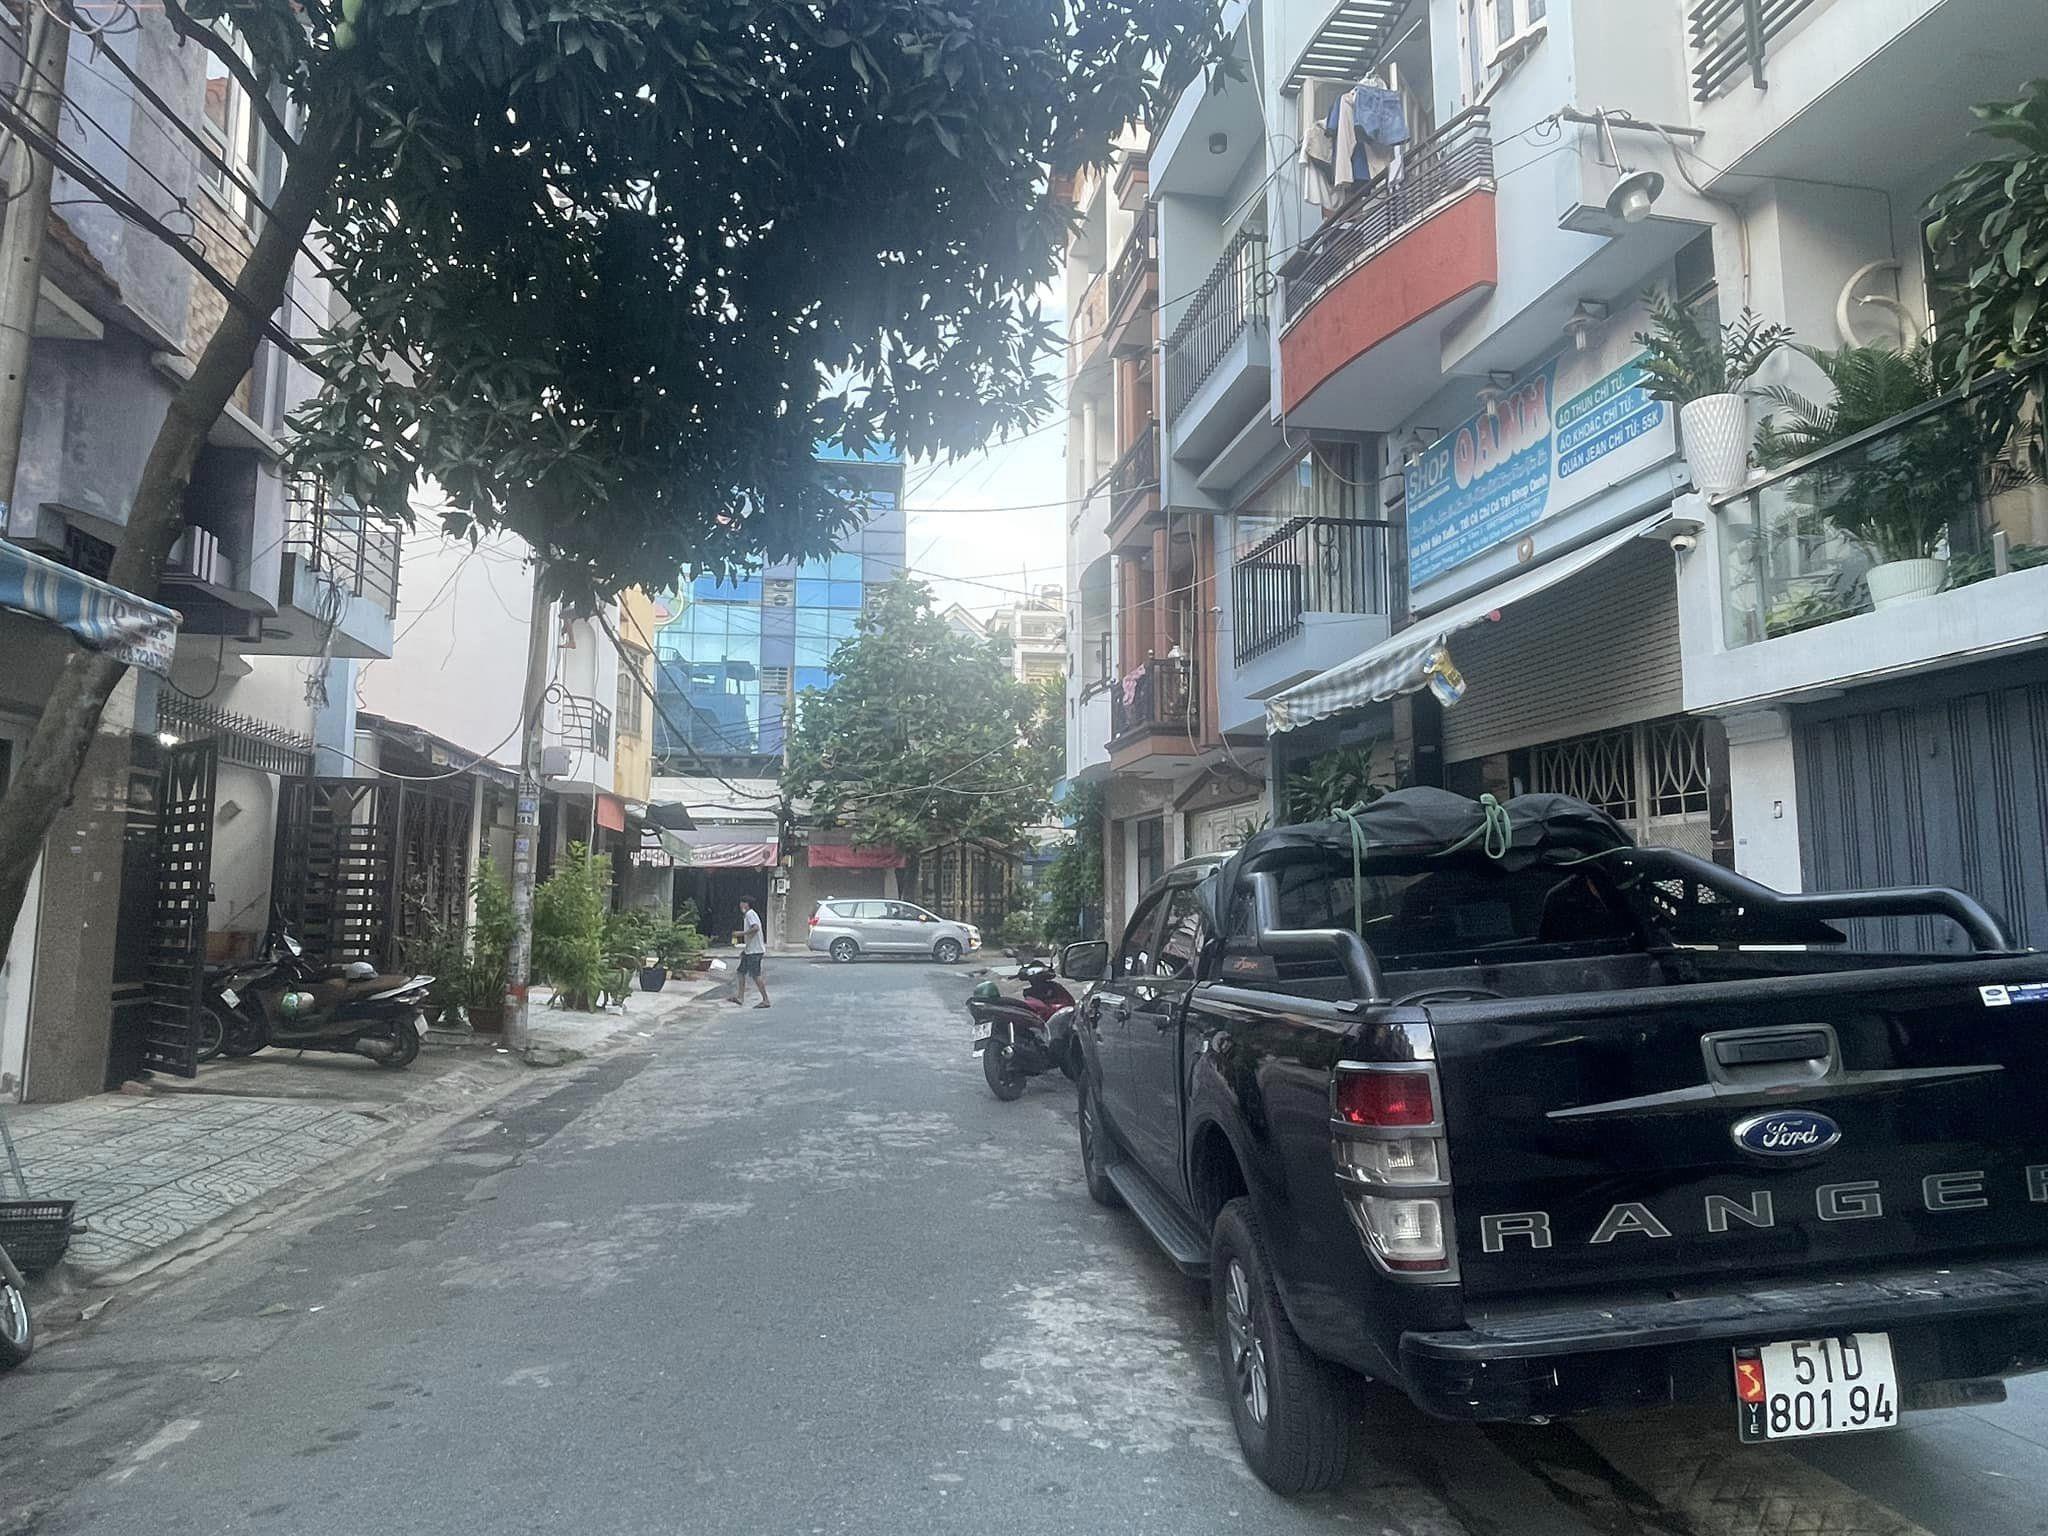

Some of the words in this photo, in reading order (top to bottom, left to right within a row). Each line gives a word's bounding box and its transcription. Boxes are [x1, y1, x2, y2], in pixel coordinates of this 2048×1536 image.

[1571, 395, 1593, 417] THUN
[1408, 449, 1449, 498] SHOP
[1453, 374, 1551, 490] OANH
[1584, 439, 1608, 463] JEAN
[1641, 409, 1660, 431] 55K
[1763, 1120, 1818, 1148] Ford
[1791, 1338, 1863, 1385] 51D
[1748, 1403, 1760, 1434] VIE
[1770, 1383, 1893, 1433] 801.94
